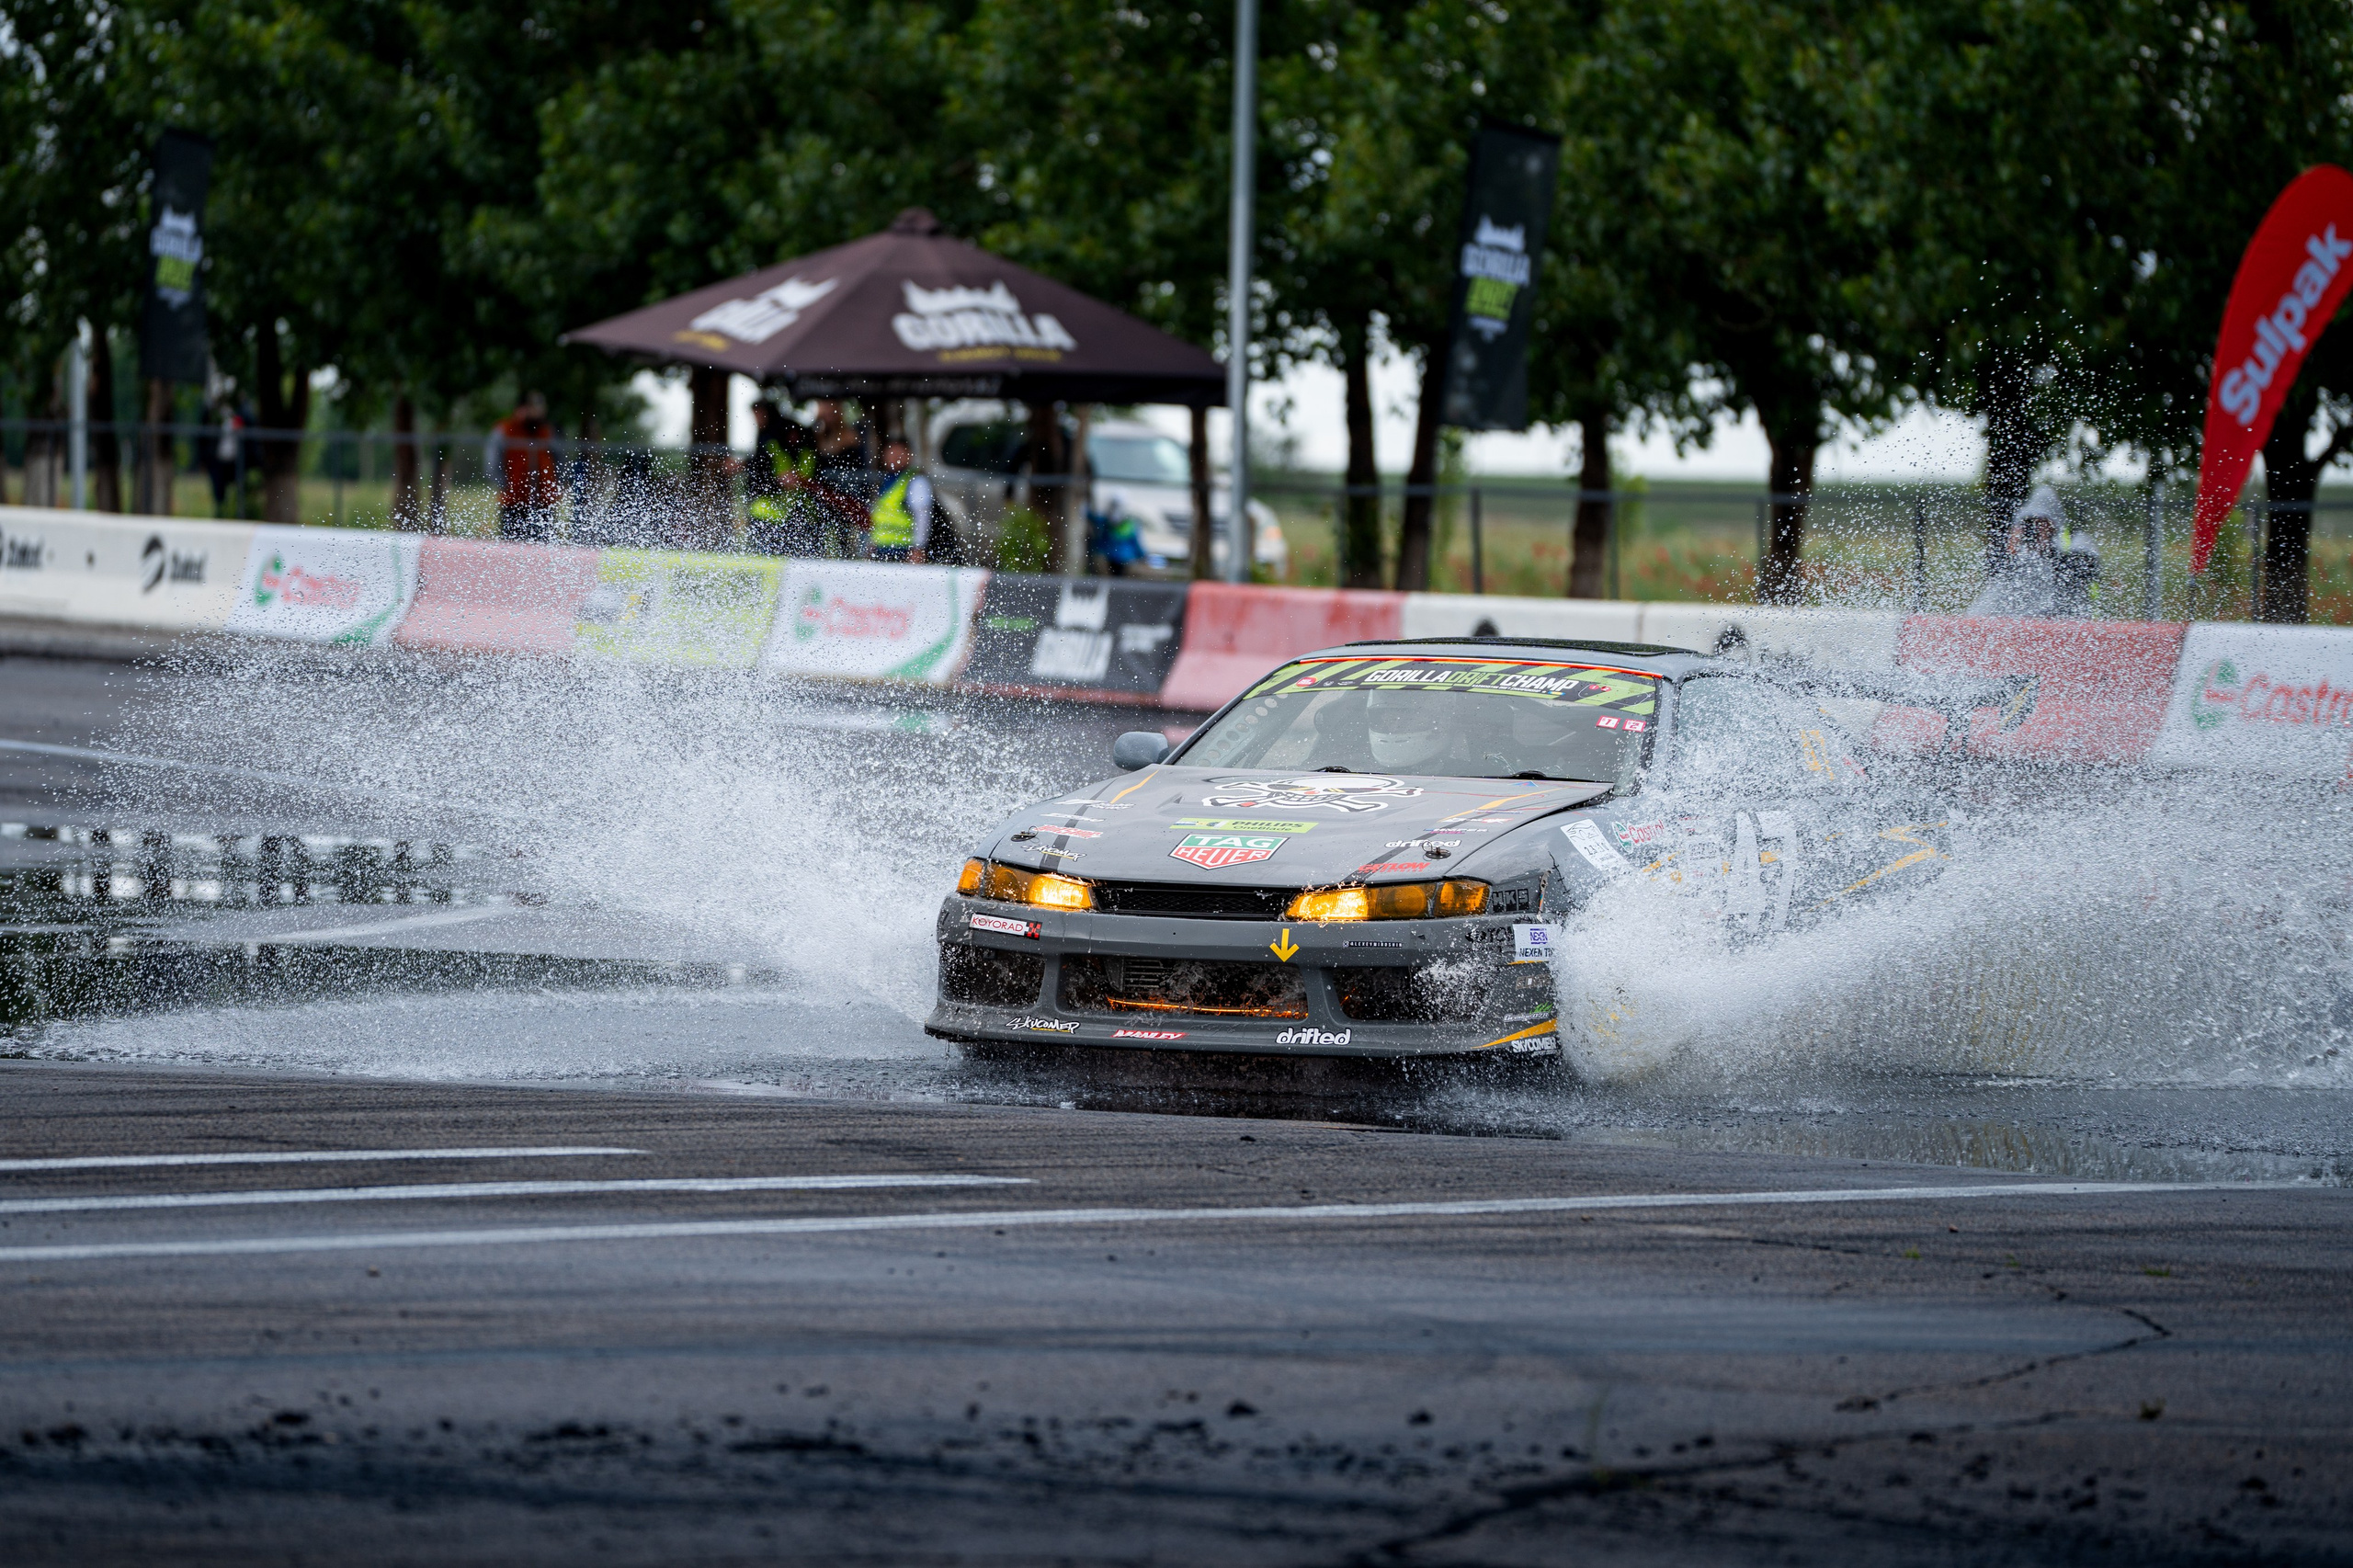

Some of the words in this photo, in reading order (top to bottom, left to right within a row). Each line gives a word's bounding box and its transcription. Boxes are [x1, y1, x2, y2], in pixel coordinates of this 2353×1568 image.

[2218, 222, 2353, 426] Sulpak
[2241, 677, 2353, 725] Castr
[1196, 836, 1274, 848] TAG
[1177, 847, 1267, 866] HEUER
[972, 917, 1024, 932] KOYORAD
[1519, 948, 1542, 957] NEXEN
[1113, 1029, 1183, 1040] MANLEY
[1276, 1028, 1351, 1045] drifted
